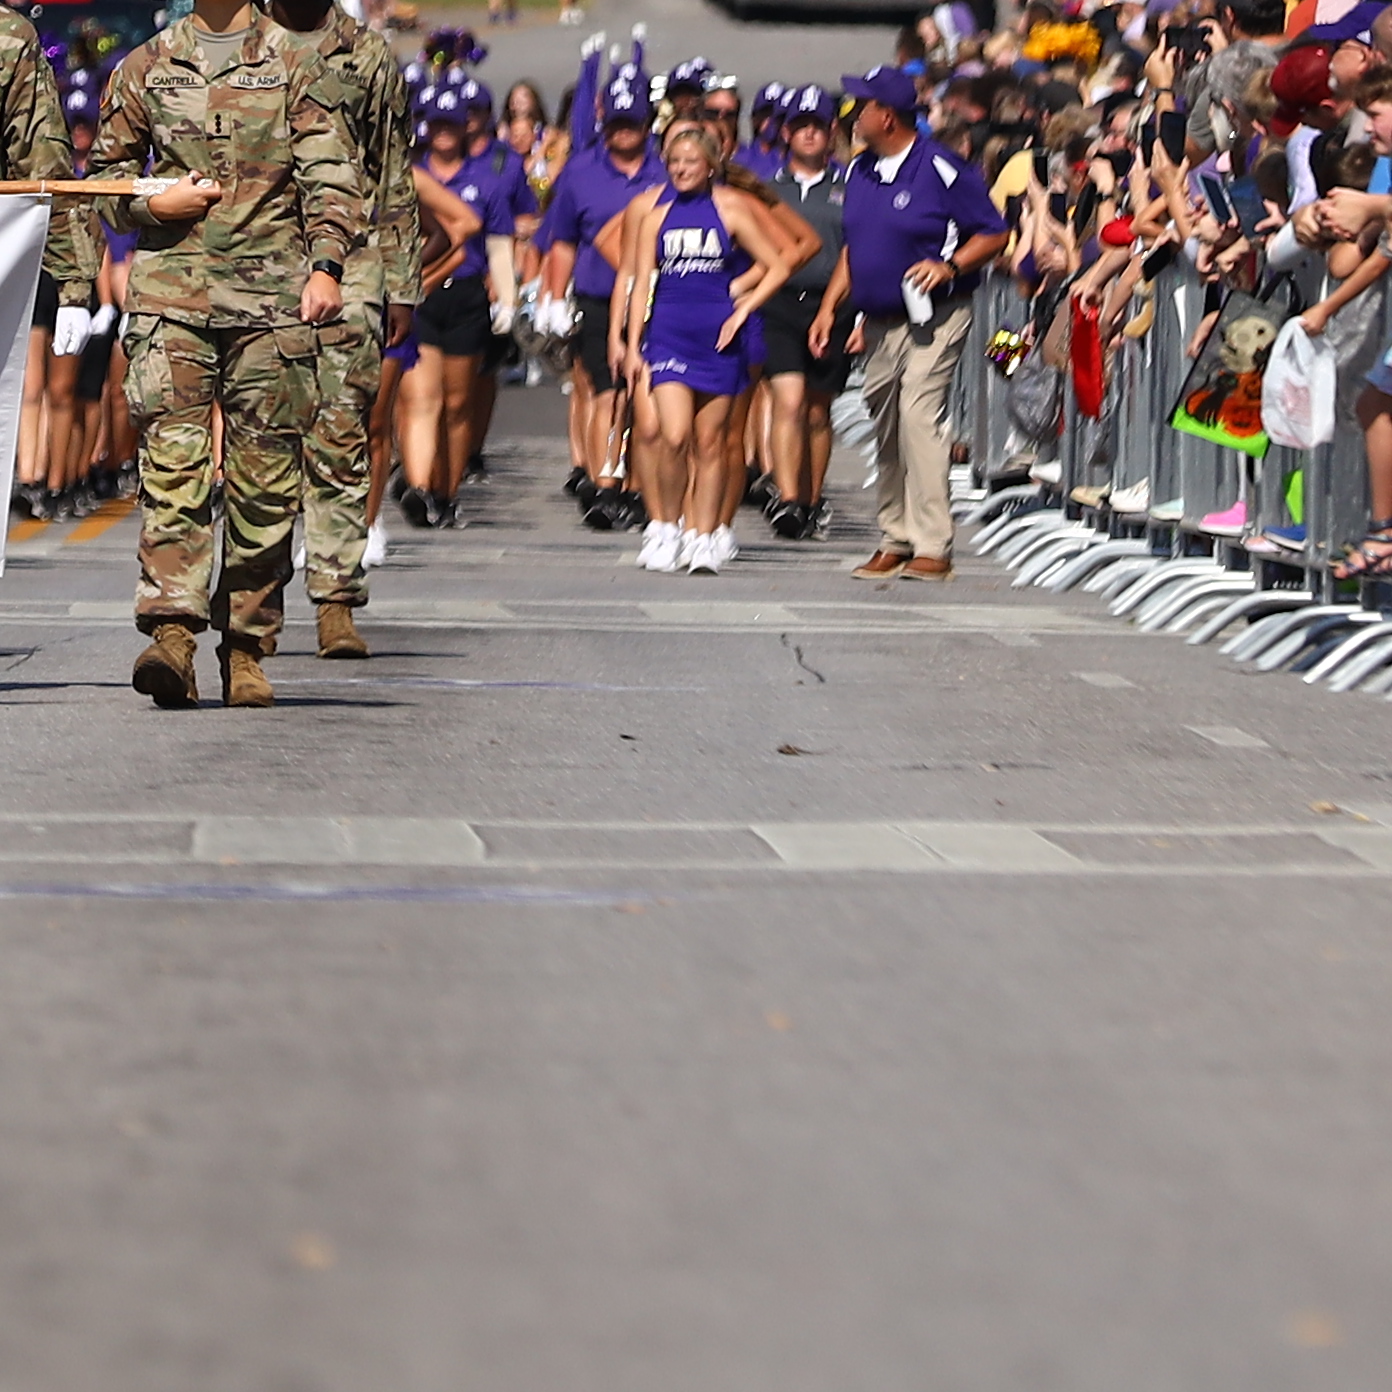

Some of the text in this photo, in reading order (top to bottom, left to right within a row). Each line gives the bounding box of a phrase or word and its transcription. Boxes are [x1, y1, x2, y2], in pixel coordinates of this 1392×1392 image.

[152, 76, 197, 86] CANTRELL
[257, 75, 282, 86] ARMY
[663, 228, 723, 258] UNA
